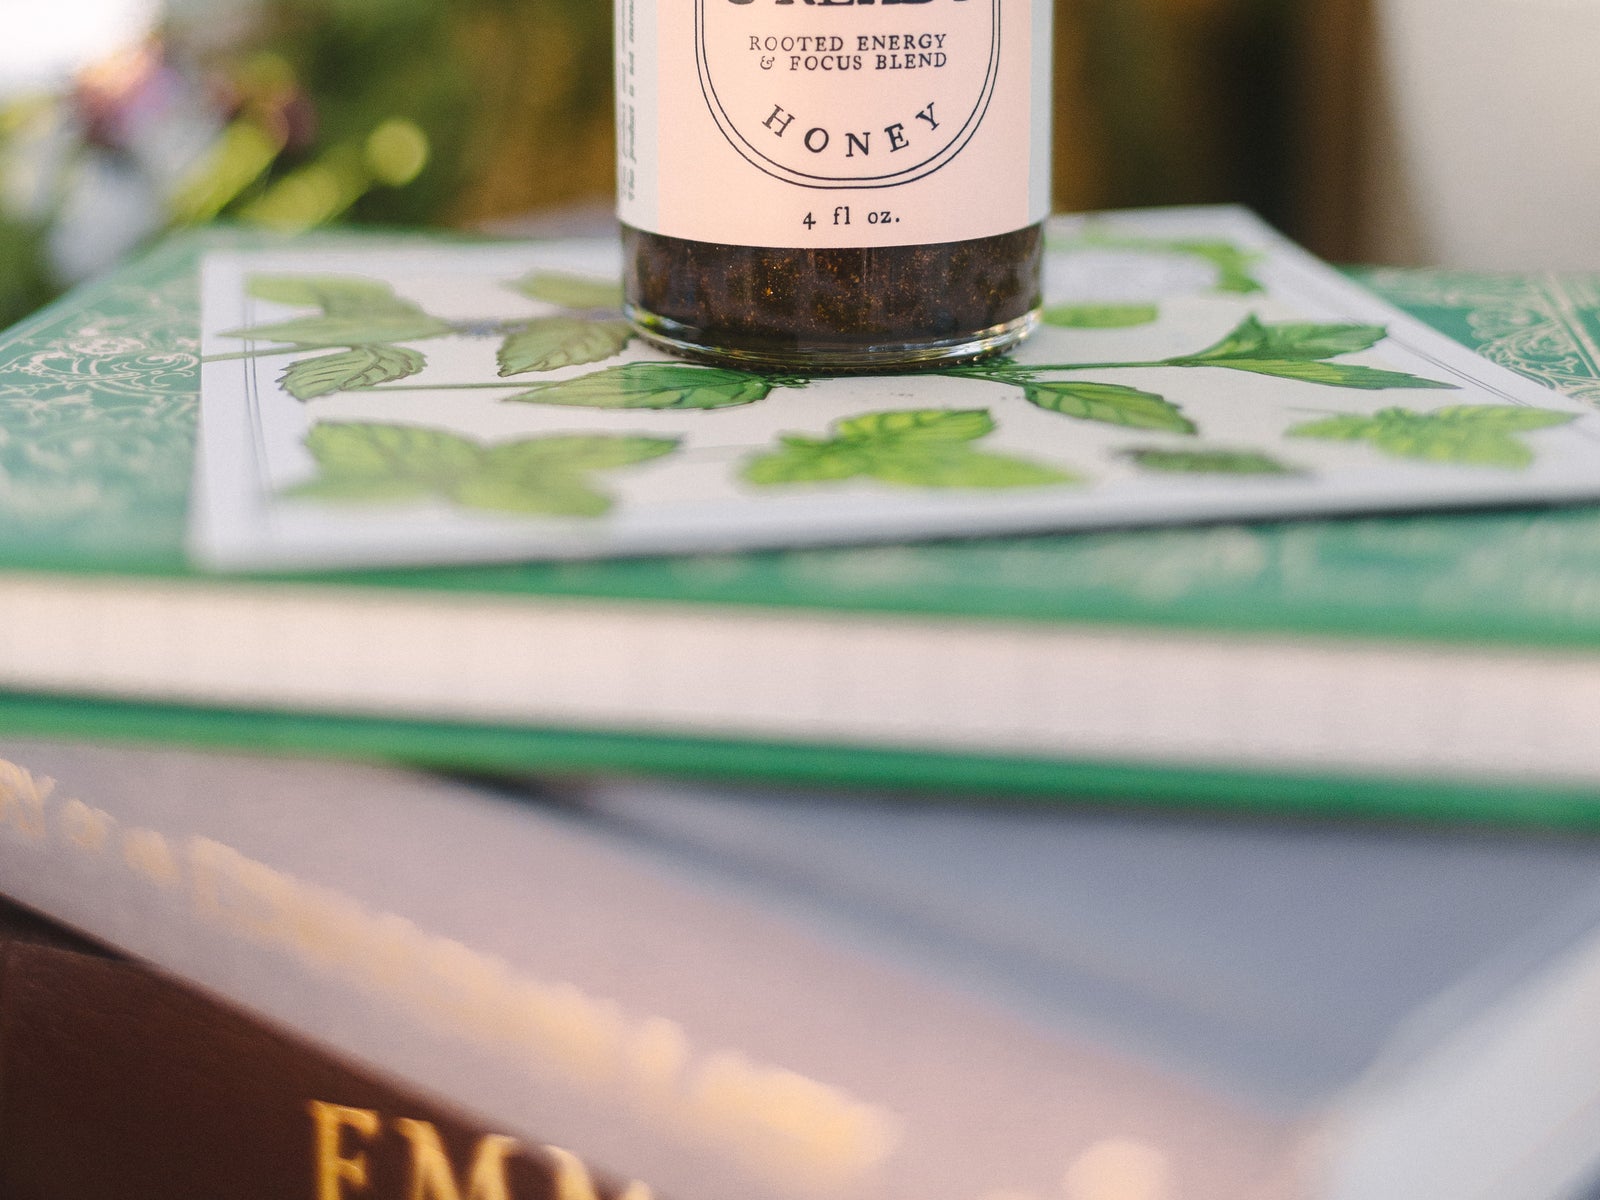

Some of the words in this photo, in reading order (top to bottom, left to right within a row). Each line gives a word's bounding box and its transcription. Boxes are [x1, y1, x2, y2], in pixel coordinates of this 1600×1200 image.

[749, 35, 844, 53] ROOTED
[856, 33, 947, 52] ENERGY
[759, 55, 776, 71] &
[789, 54, 863, 72] FOCUS
[874, 51, 947, 71] BLEND
[762, 103, 939, 158] HONEY
[802, 211, 817, 231] 4
[832, 205, 851, 226] fl
[867, 210, 900, 225] oz.
